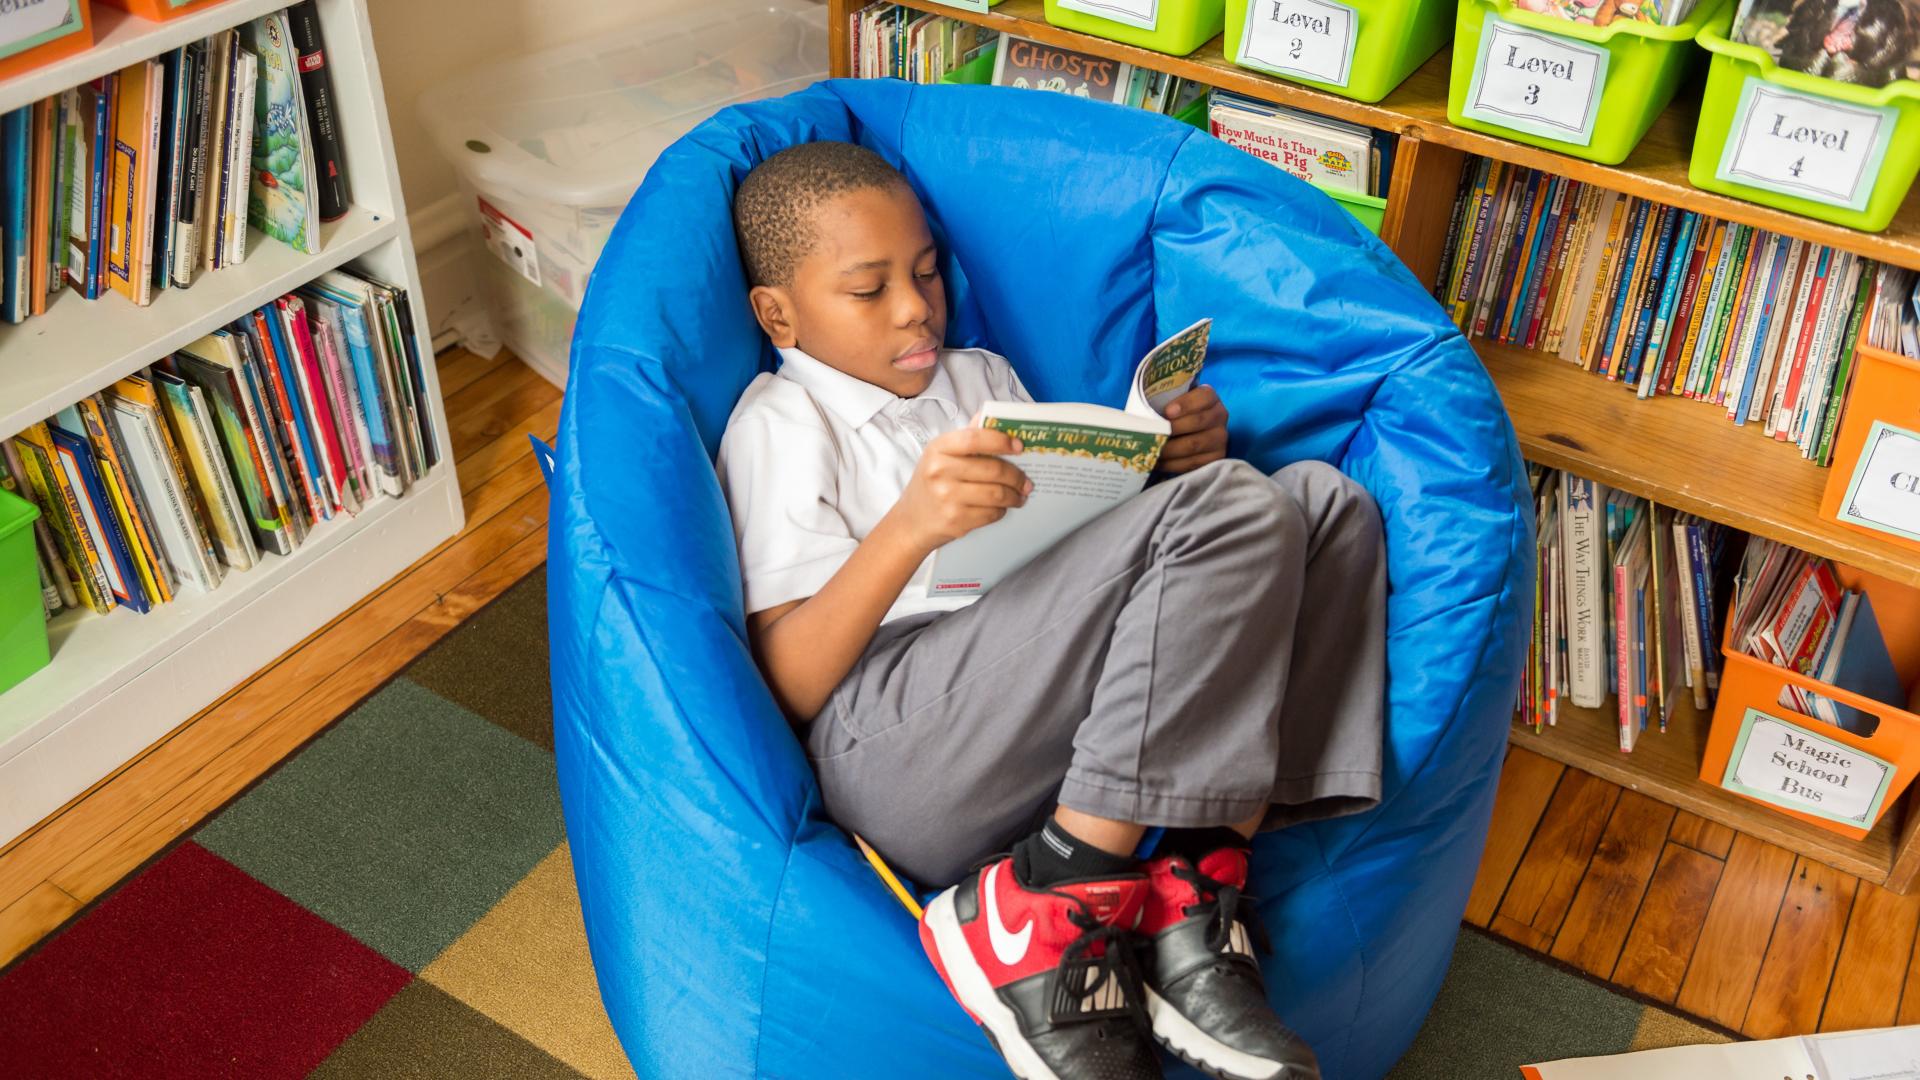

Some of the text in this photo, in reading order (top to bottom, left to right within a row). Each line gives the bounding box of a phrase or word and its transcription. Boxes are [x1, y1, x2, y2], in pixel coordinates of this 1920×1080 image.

[1271, 1, 1331, 37] Level
[1010, 41, 1113, 88] GHOSTS
[1290, 38, 1304, 60] 2
[1503, 45, 1575, 83] Level
[1524, 83, 1540, 106] 3
[1218, 123, 1317, 157] How Much Is That
[1768, 113, 1849, 153] Level
[1264, 151, 1287, 172] Pig
[1788, 155, 1805, 178] 4
[1006, 429, 1049, 442] MAGIC
[1056, 431, 1089, 444] TREE
[1095, 436, 1143, 450] HOUSE
[1573, 513, 1592, 642] THE WAY THINGS WORK
[1695, 572, 1706, 606] COMMANDER
[1699, 607, 1707, 621] TOAD
[1575, 648, 1584, 682] MACAULAY
[1783, 733, 1852, 769] Magic
[1770, 751, 1849, 789] School
[1780, 777, 1823, 803] Bus
